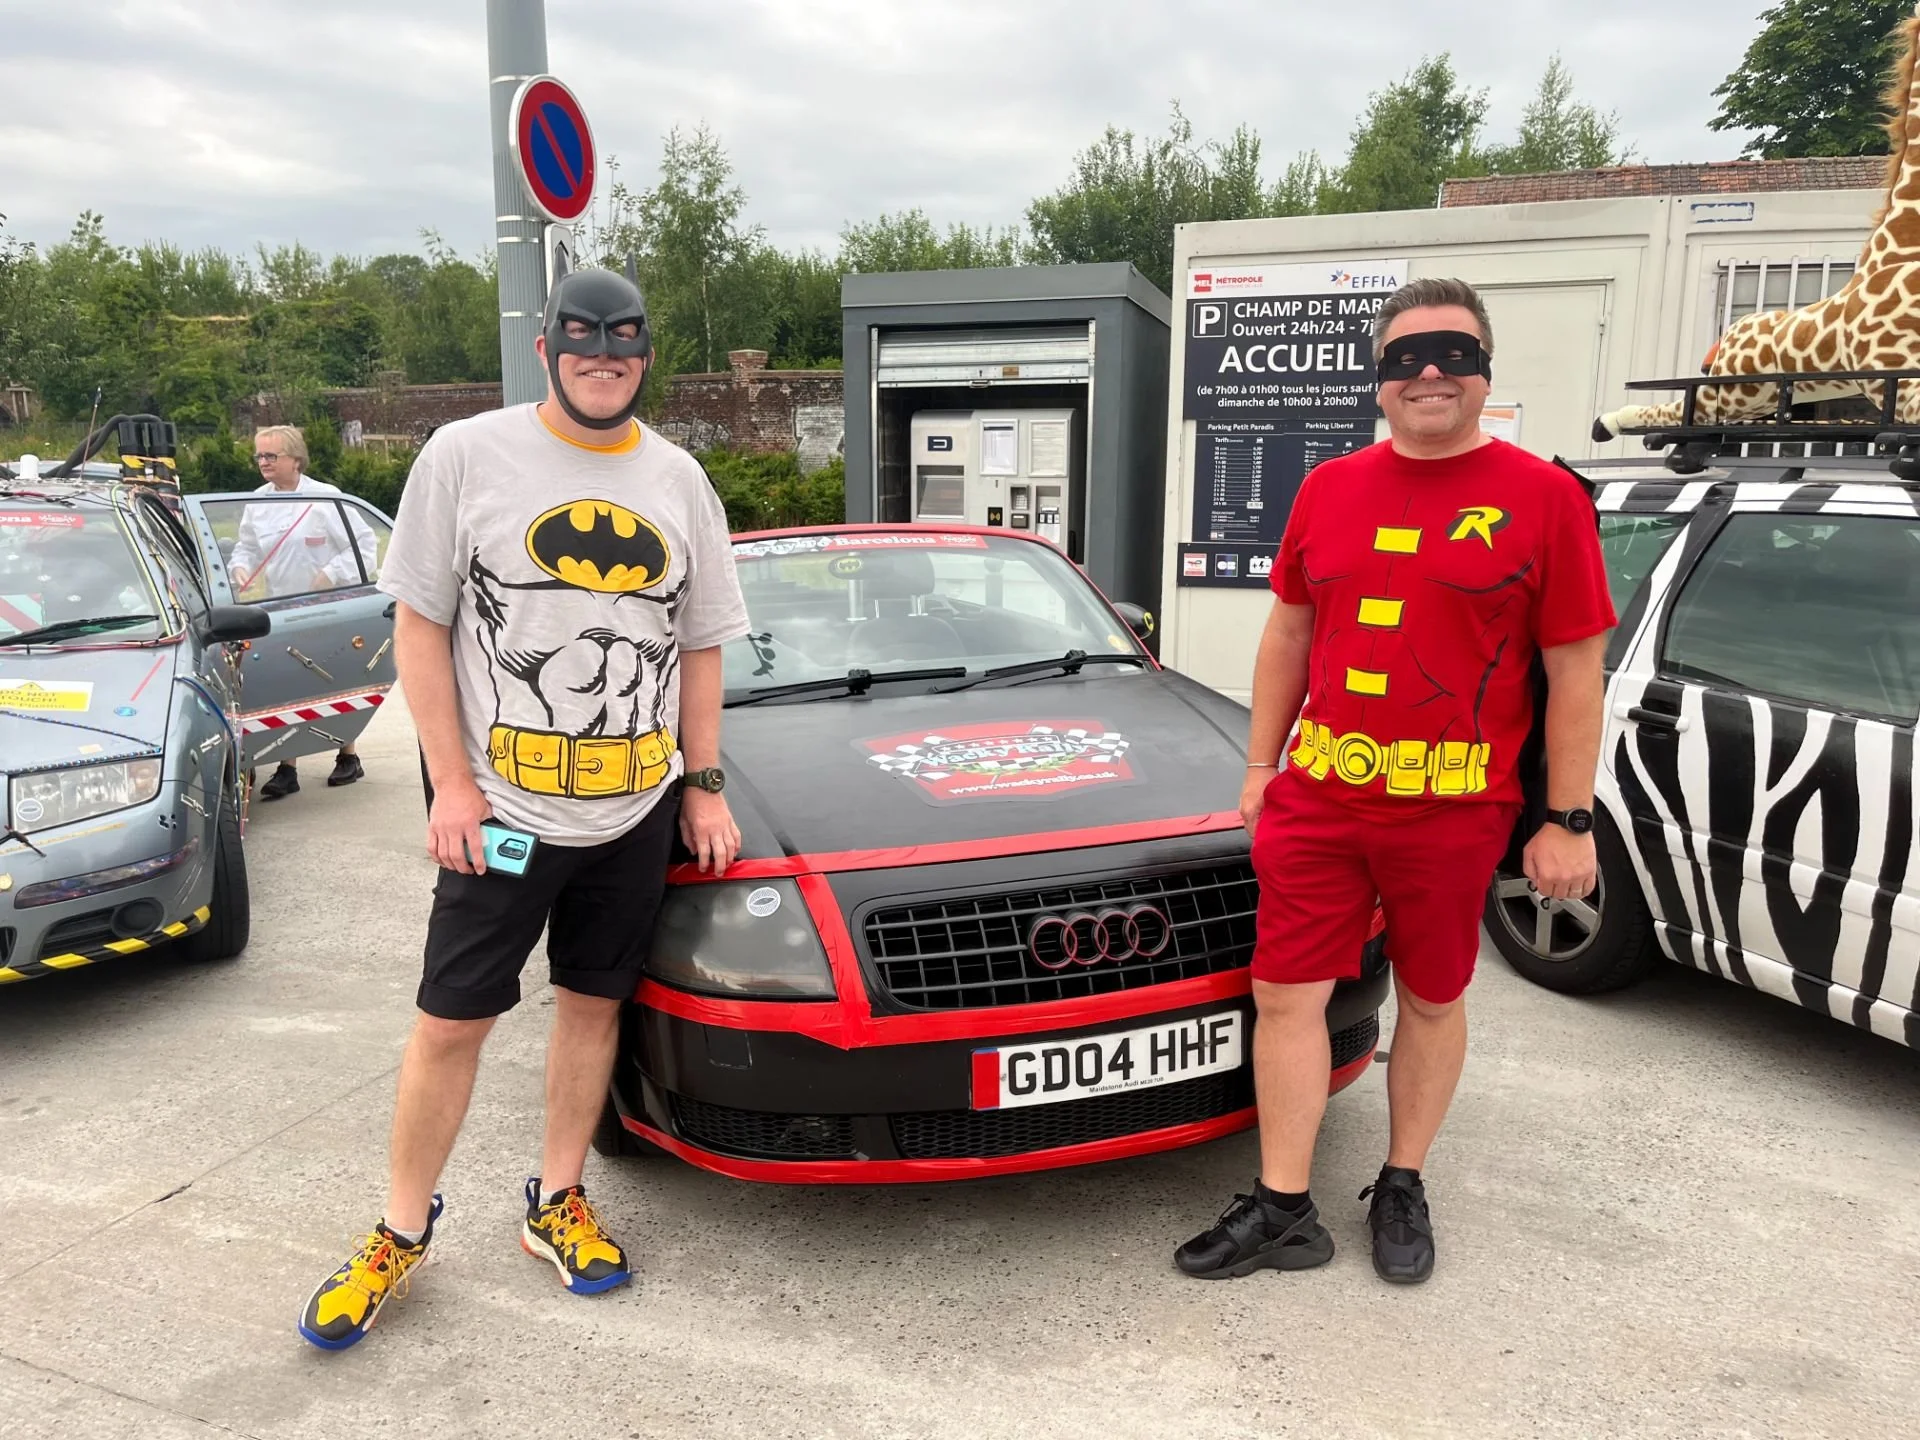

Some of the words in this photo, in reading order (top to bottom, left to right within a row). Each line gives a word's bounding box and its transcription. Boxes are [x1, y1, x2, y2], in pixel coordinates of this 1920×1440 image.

[1352, 275, 1397, 289] EFFIA
[1234, 301, 1302, 318] CHAMP
[1308, 299, 1334, 316] DE
[1199, 305, 1221, 335] P
[1232, 321, 1286, 337] Ouvert
[1290, 319, 1345, 335] 24h/24
[1218, 342, 1364, 373] ACCUEIL
[1197, 385, 1213, 396] (de
[1215, 385, 1239, 395] 7h00
[1241, 384, 1248, 394] à
[1249, 384, 1280, 394] 01h00
[1282, 384, 1304, 394] tous
[1306, 383, 1320, 393] les
[1321, 383, 1348, 396] jours
[1350, 382, 1373, 393] sauf
[1217, 397, 1265, 407] dimanche
[1267, 397, 1280, 407] de
[1283, 396, 1312, 406] 10h00
[1314, 396, 1321, 406] à
[1324, 395, 1358, 407] 20h00)
[1207, 423, 1232, 432] Parking
[1233, 423, 1249, 431] Petit
[1250, 423, 1275, 431] Paradis
[1305, 422, 1330, 431] Parking
[1330, 422, 1354, 430] Liberté
[1448, 506, 1504, 551] R
[833, 535, 936, 546] Barcelona
[920, 745, 1010, 767] Wacky
[1015, 741, 1090, 755] Rally
[1008, 1037, 1134, 1096] GD04
[1150, 1017, 1233, 1076] HHF
[1124, 1080, 1139, 1088] Audi
